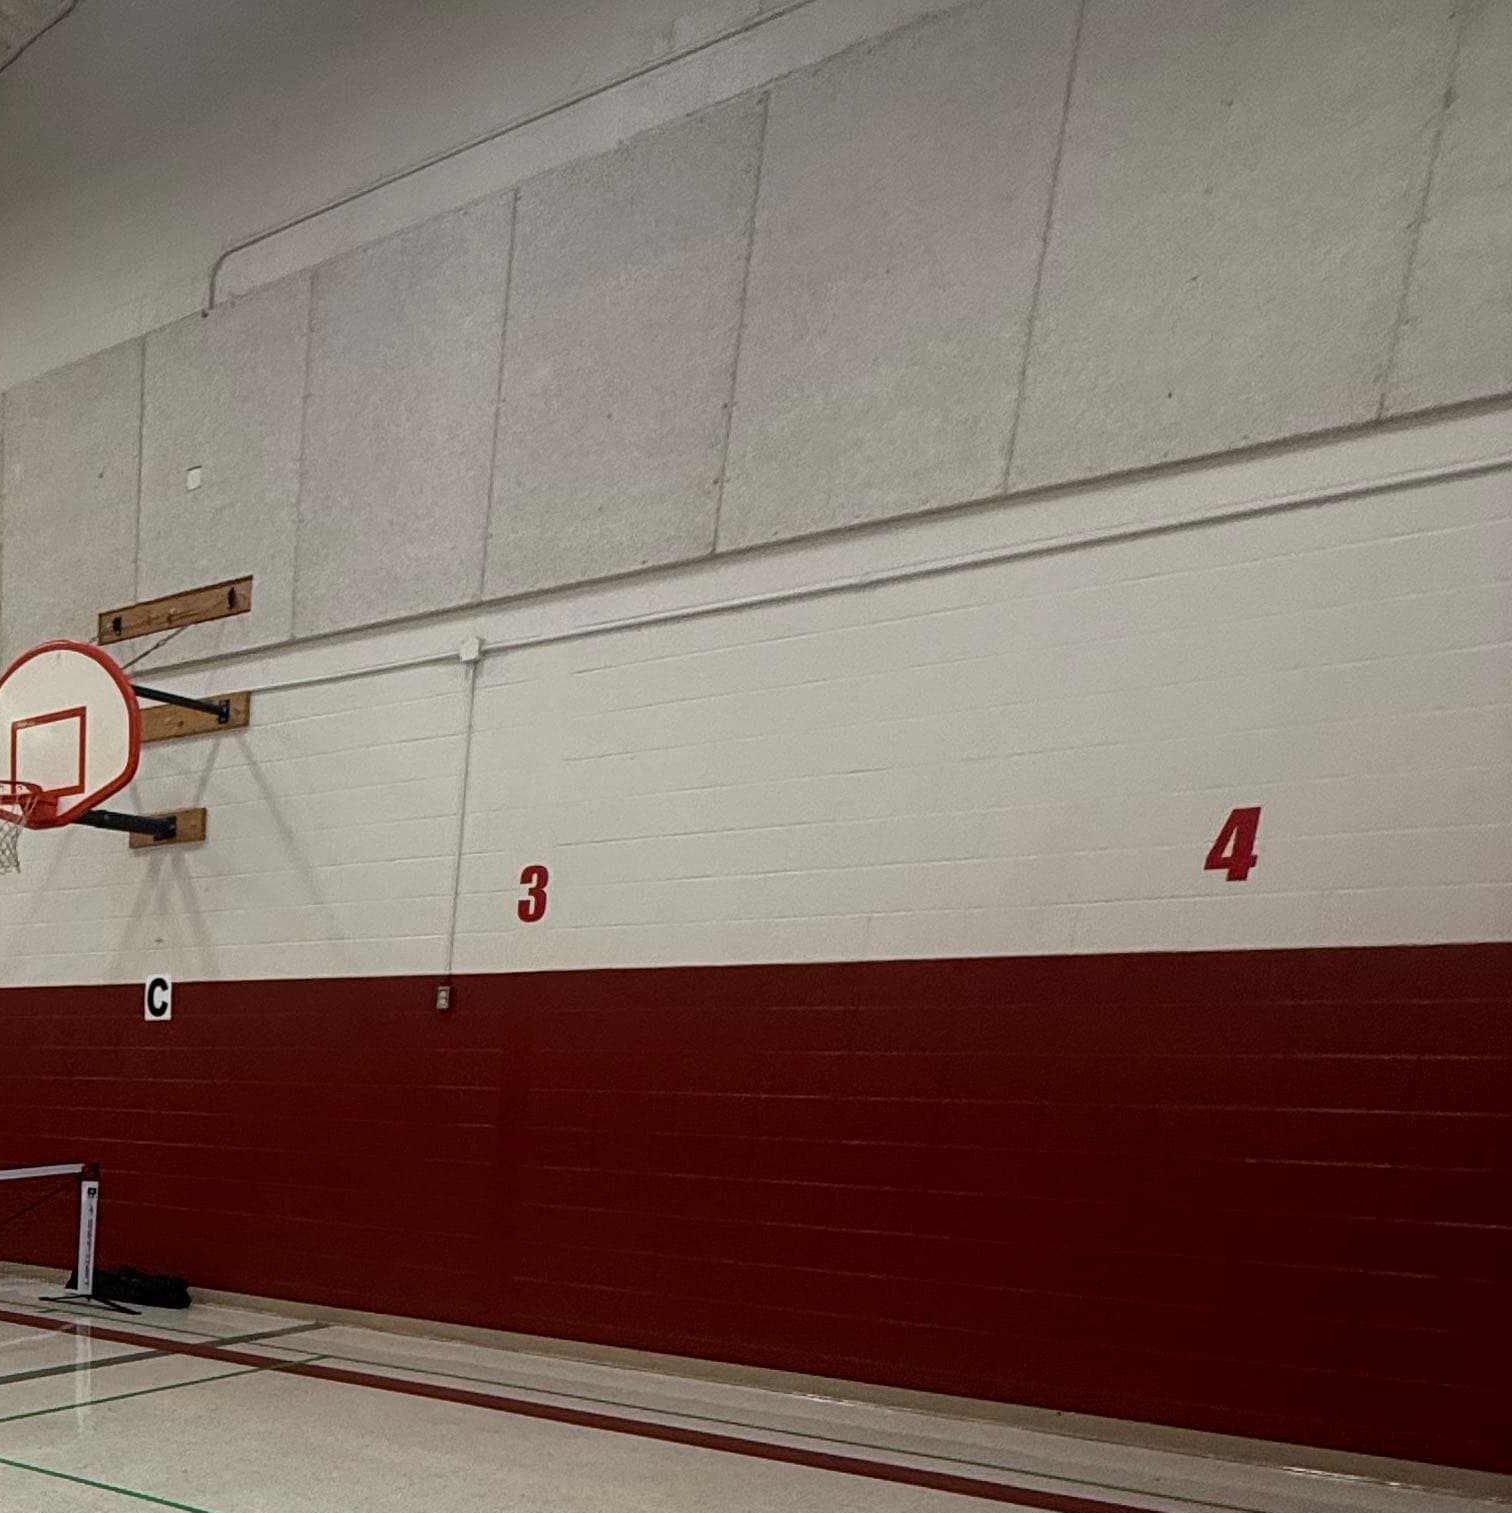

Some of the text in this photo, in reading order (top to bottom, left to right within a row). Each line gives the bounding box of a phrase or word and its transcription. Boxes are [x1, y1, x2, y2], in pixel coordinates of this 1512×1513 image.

[1204, 805, 1261, 882] 4
[517, 864, 549, 923] 3
[147, 977, 169, 1017] C
